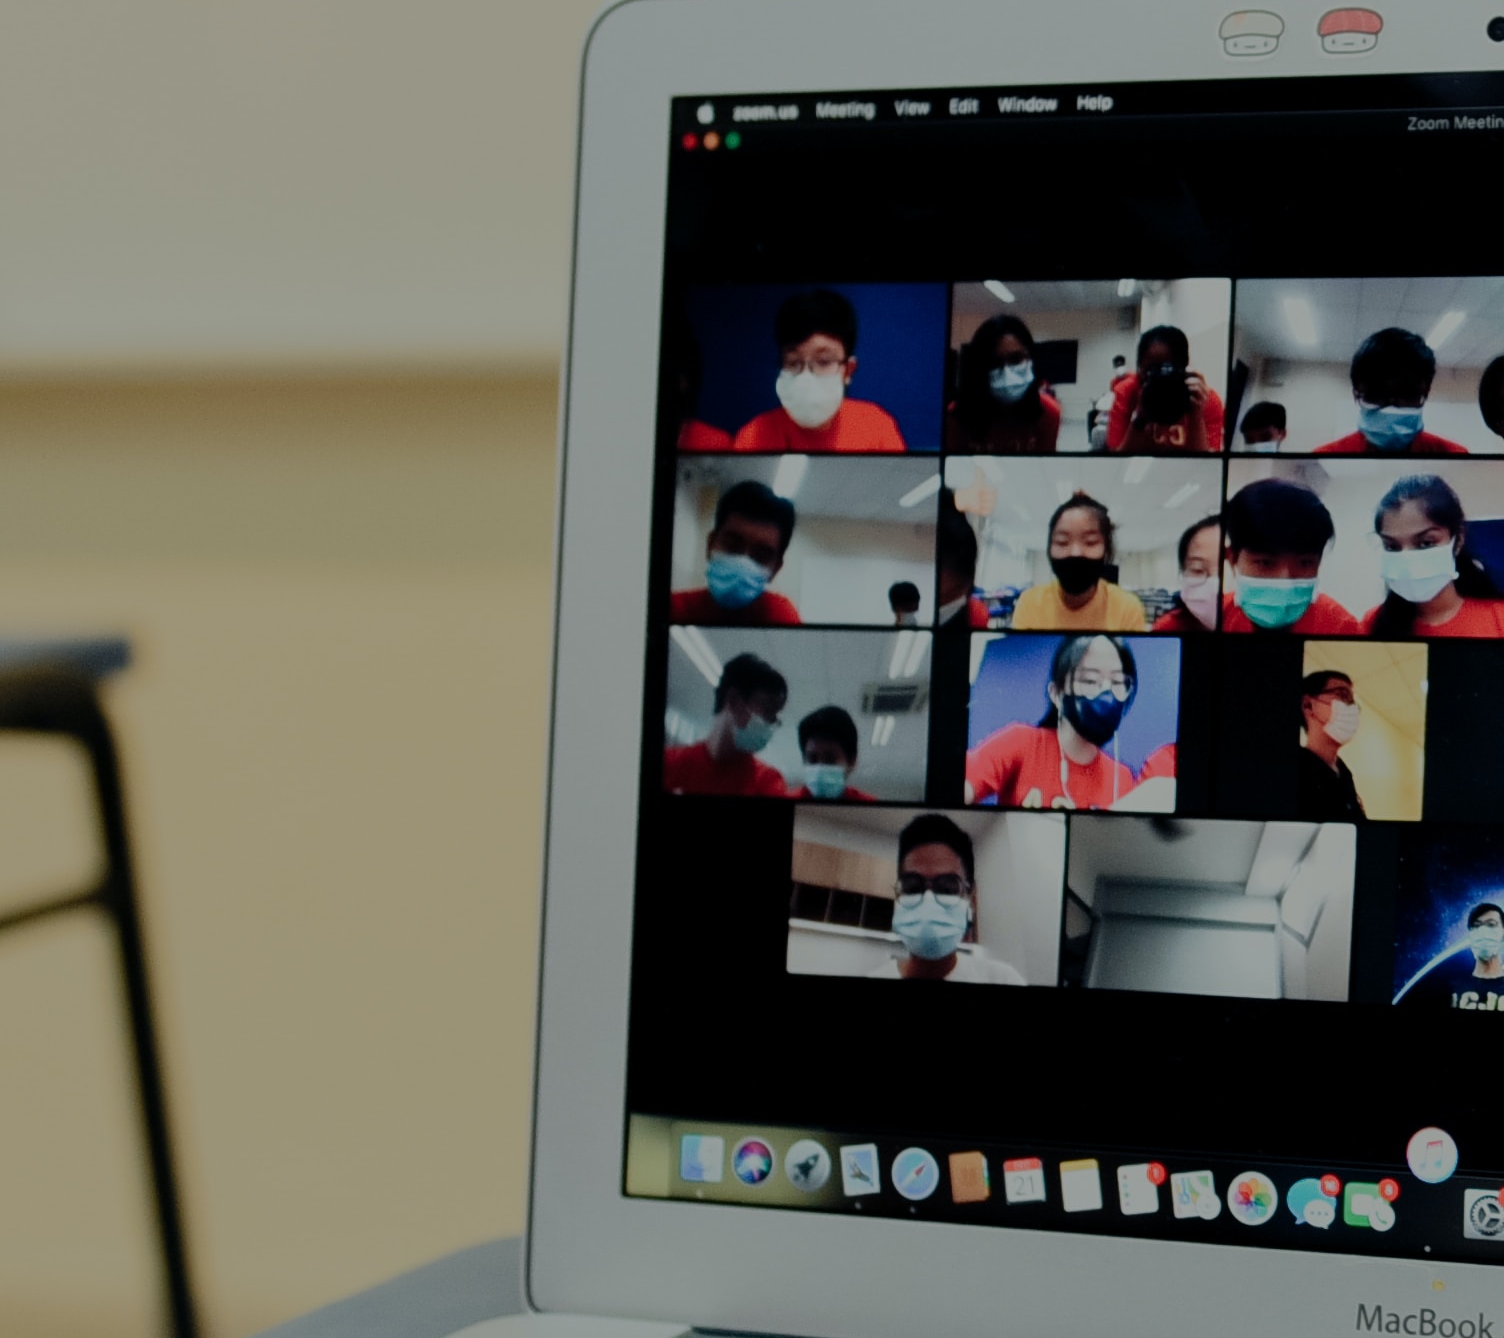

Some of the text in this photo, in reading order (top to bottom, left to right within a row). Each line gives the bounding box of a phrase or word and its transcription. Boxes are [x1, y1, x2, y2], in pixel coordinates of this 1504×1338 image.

[816, 102, 875, 119] Meeting
[895, 100, 929, 115] View
[949, 98, 978, 114] Edit
[998, 97, 1057, 112] Window
[1077, 95, 1113, 111] Help
[1408, 117, 1449, 130] Zoom
[1014, 1175, 1035, 1196] 21
